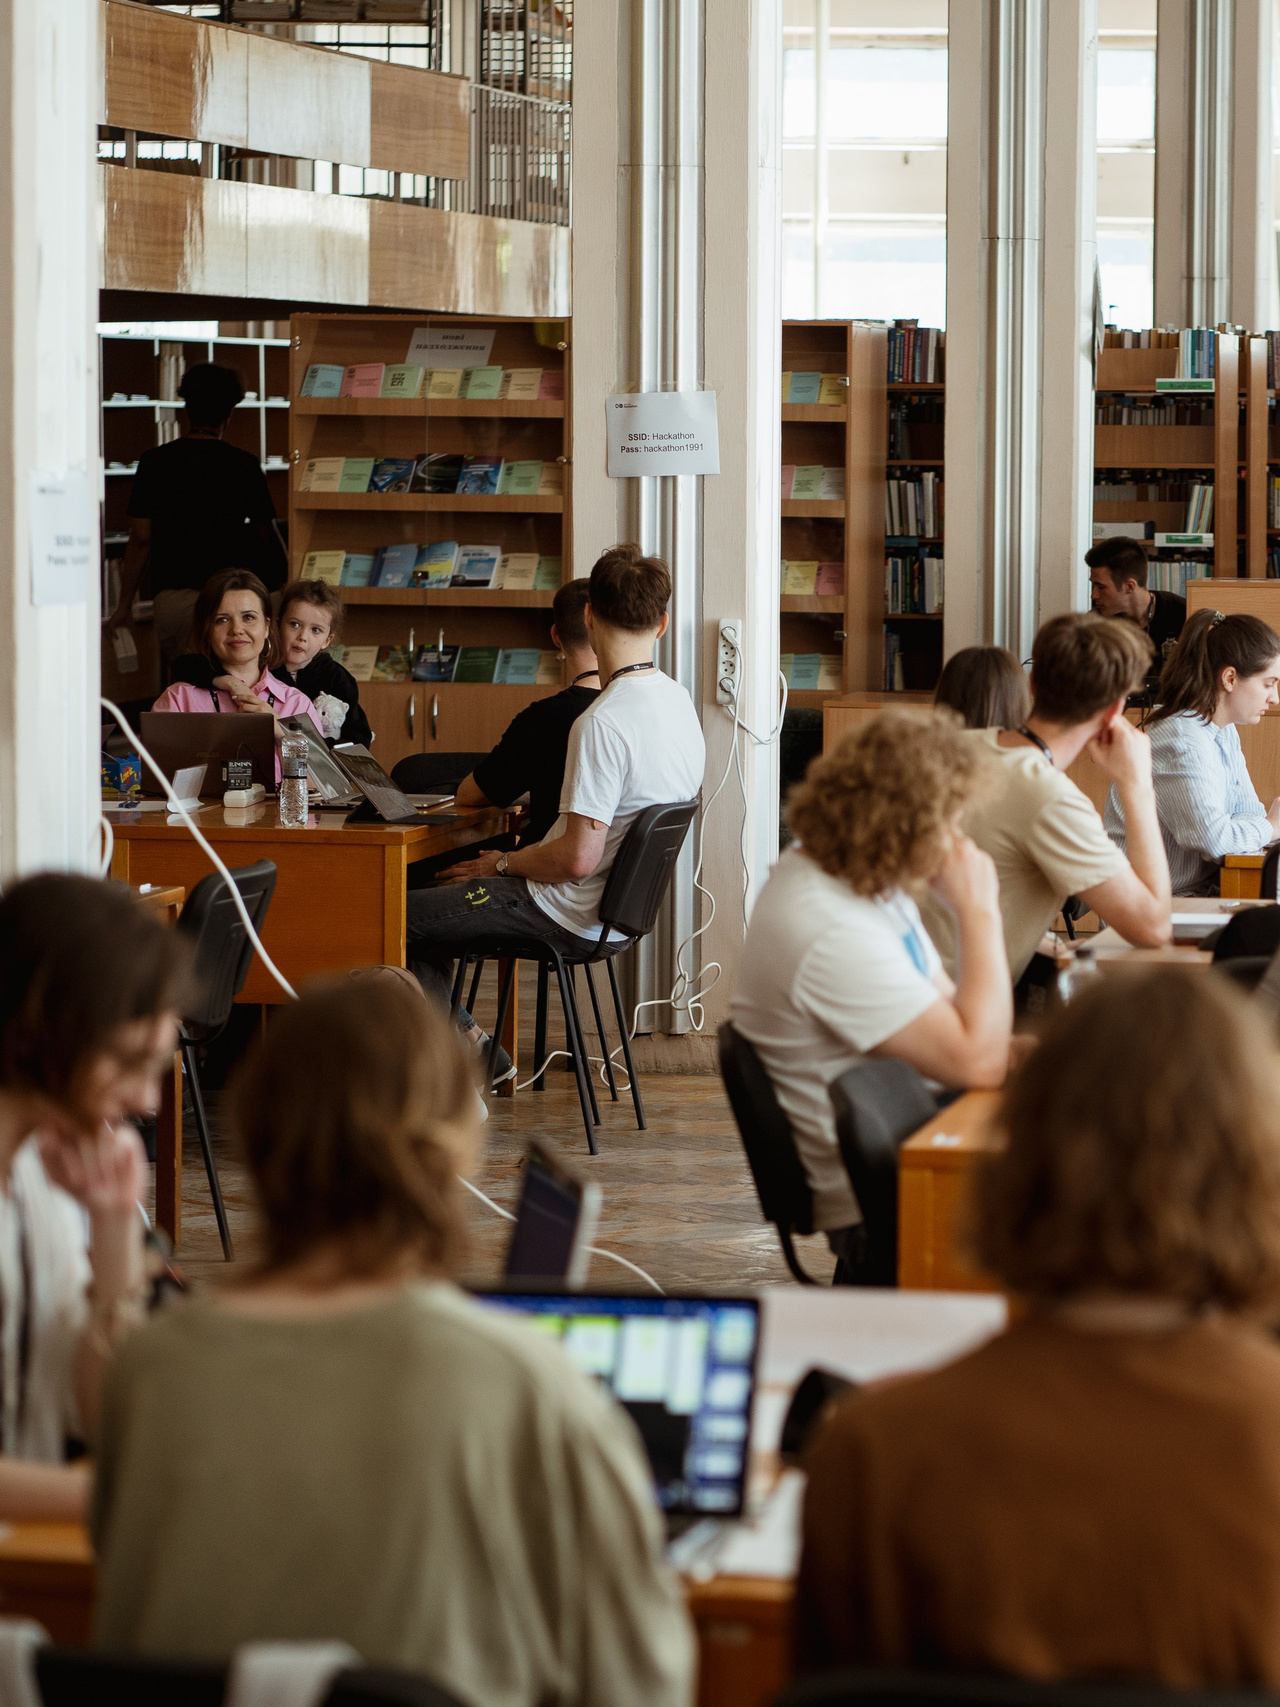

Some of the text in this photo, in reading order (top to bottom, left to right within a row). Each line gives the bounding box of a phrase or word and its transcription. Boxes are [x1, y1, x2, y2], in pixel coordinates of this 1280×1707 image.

[628, 432, 695, 442] SSID: Hackathon
[620, 443, 704, 454] Pass: hackathon1991
